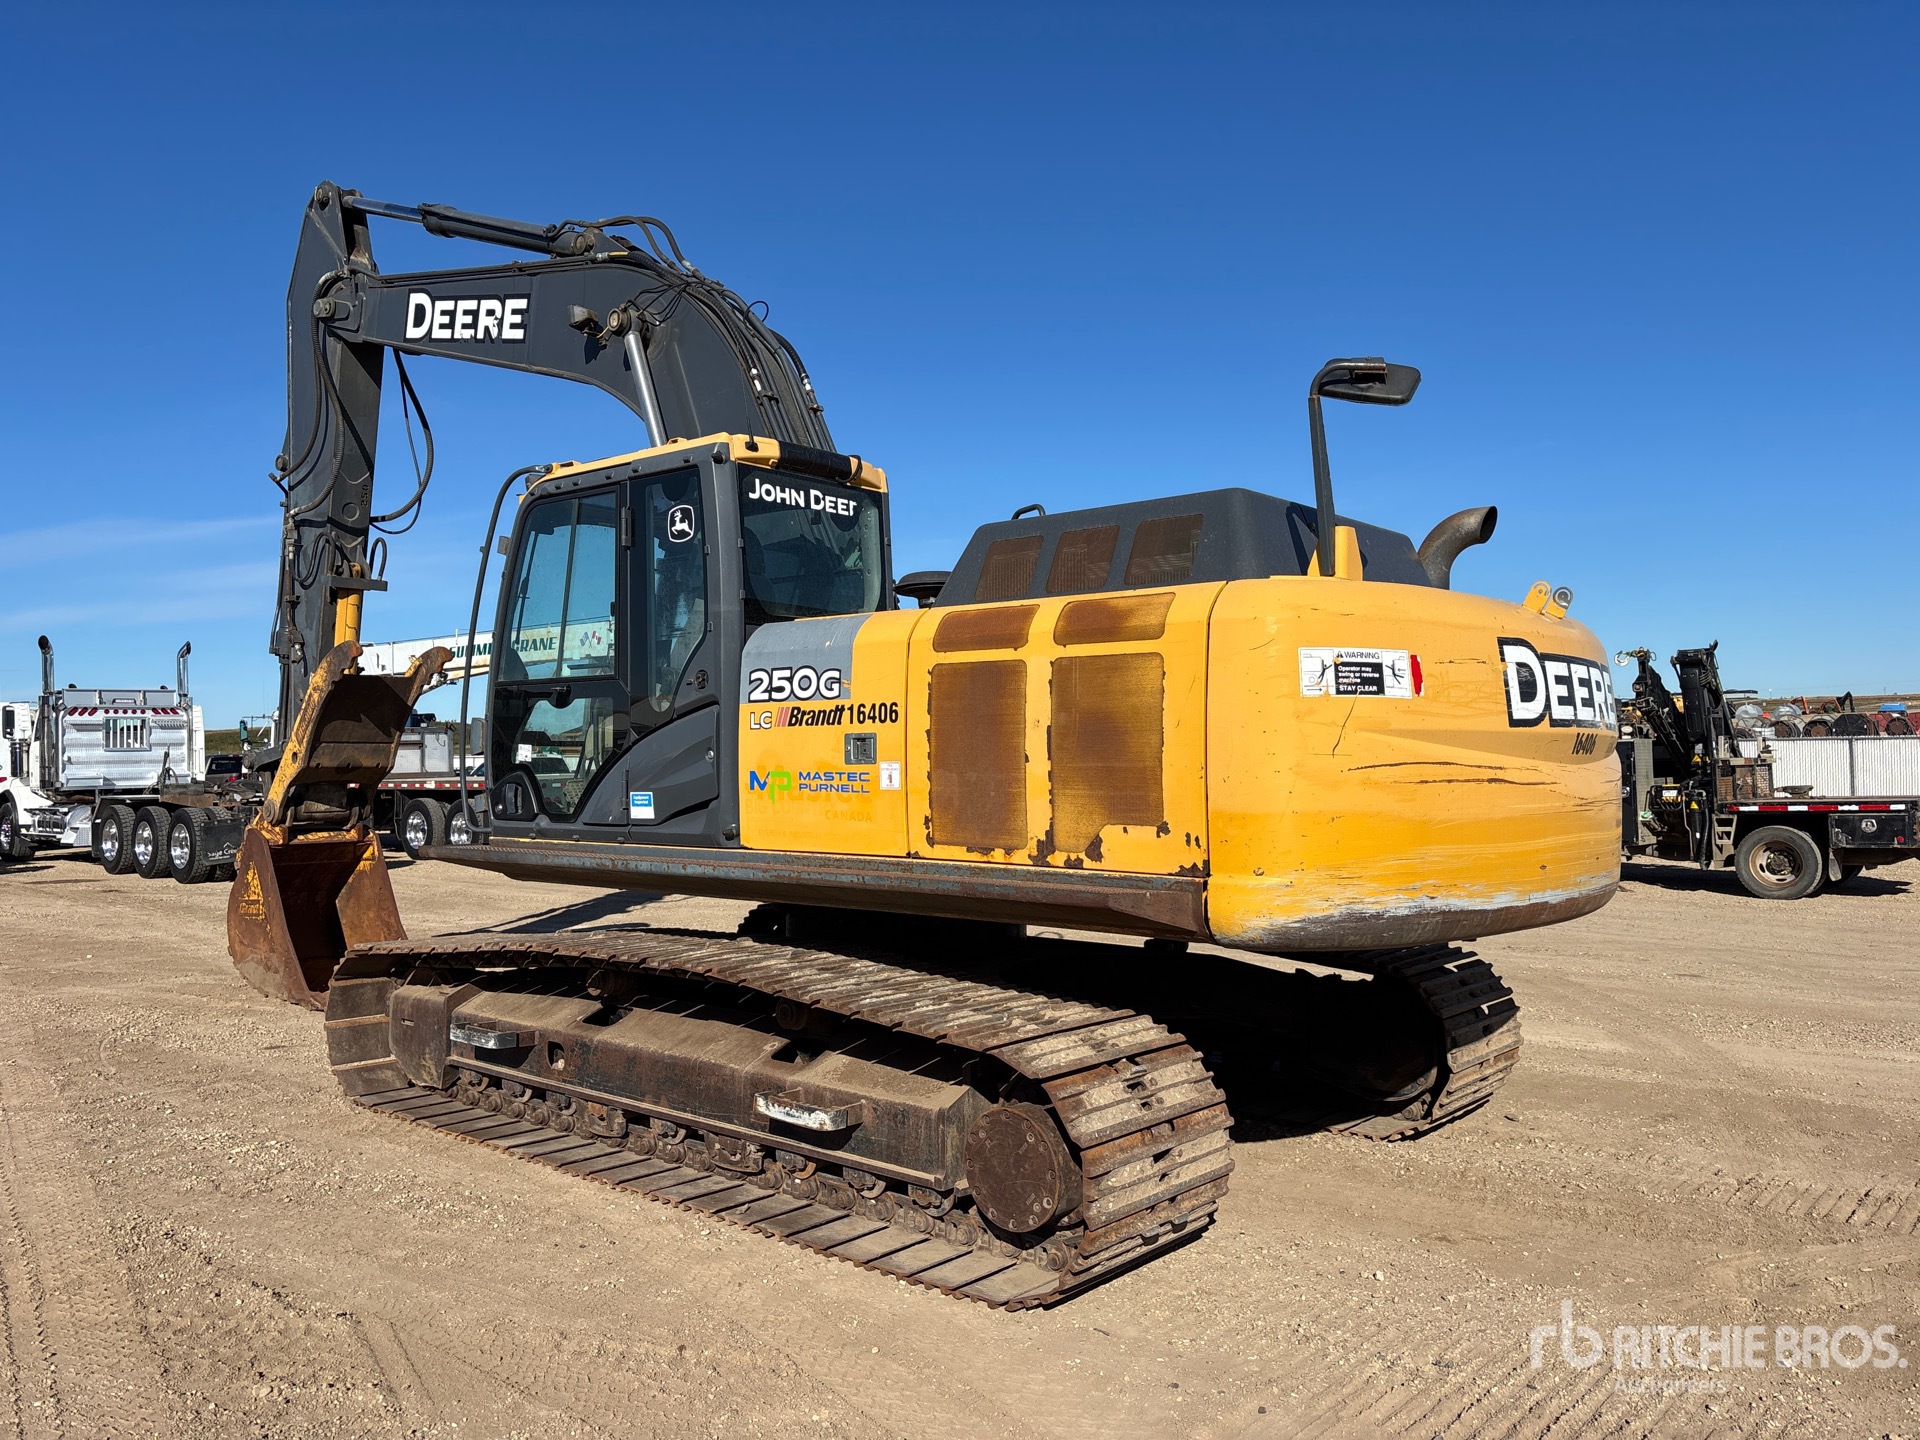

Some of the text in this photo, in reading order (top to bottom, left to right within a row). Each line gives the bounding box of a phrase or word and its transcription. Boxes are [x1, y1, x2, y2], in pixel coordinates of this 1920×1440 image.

[404, 291, 529, 341] DEERE
[748, 478, 805, 507] JOHN
[1343, 651, 1380, 660] WARNING
[748, 666, 841, 703] 250G
[1501, 644, 1617, 725] DEERE
[749, 702, 899, 729] LC Brandt 16406
[1571, 732, 1598, 755] 16406
[798, 771, 870, 782] MASTEC
[798, 783, 870, 794] PURNELL
